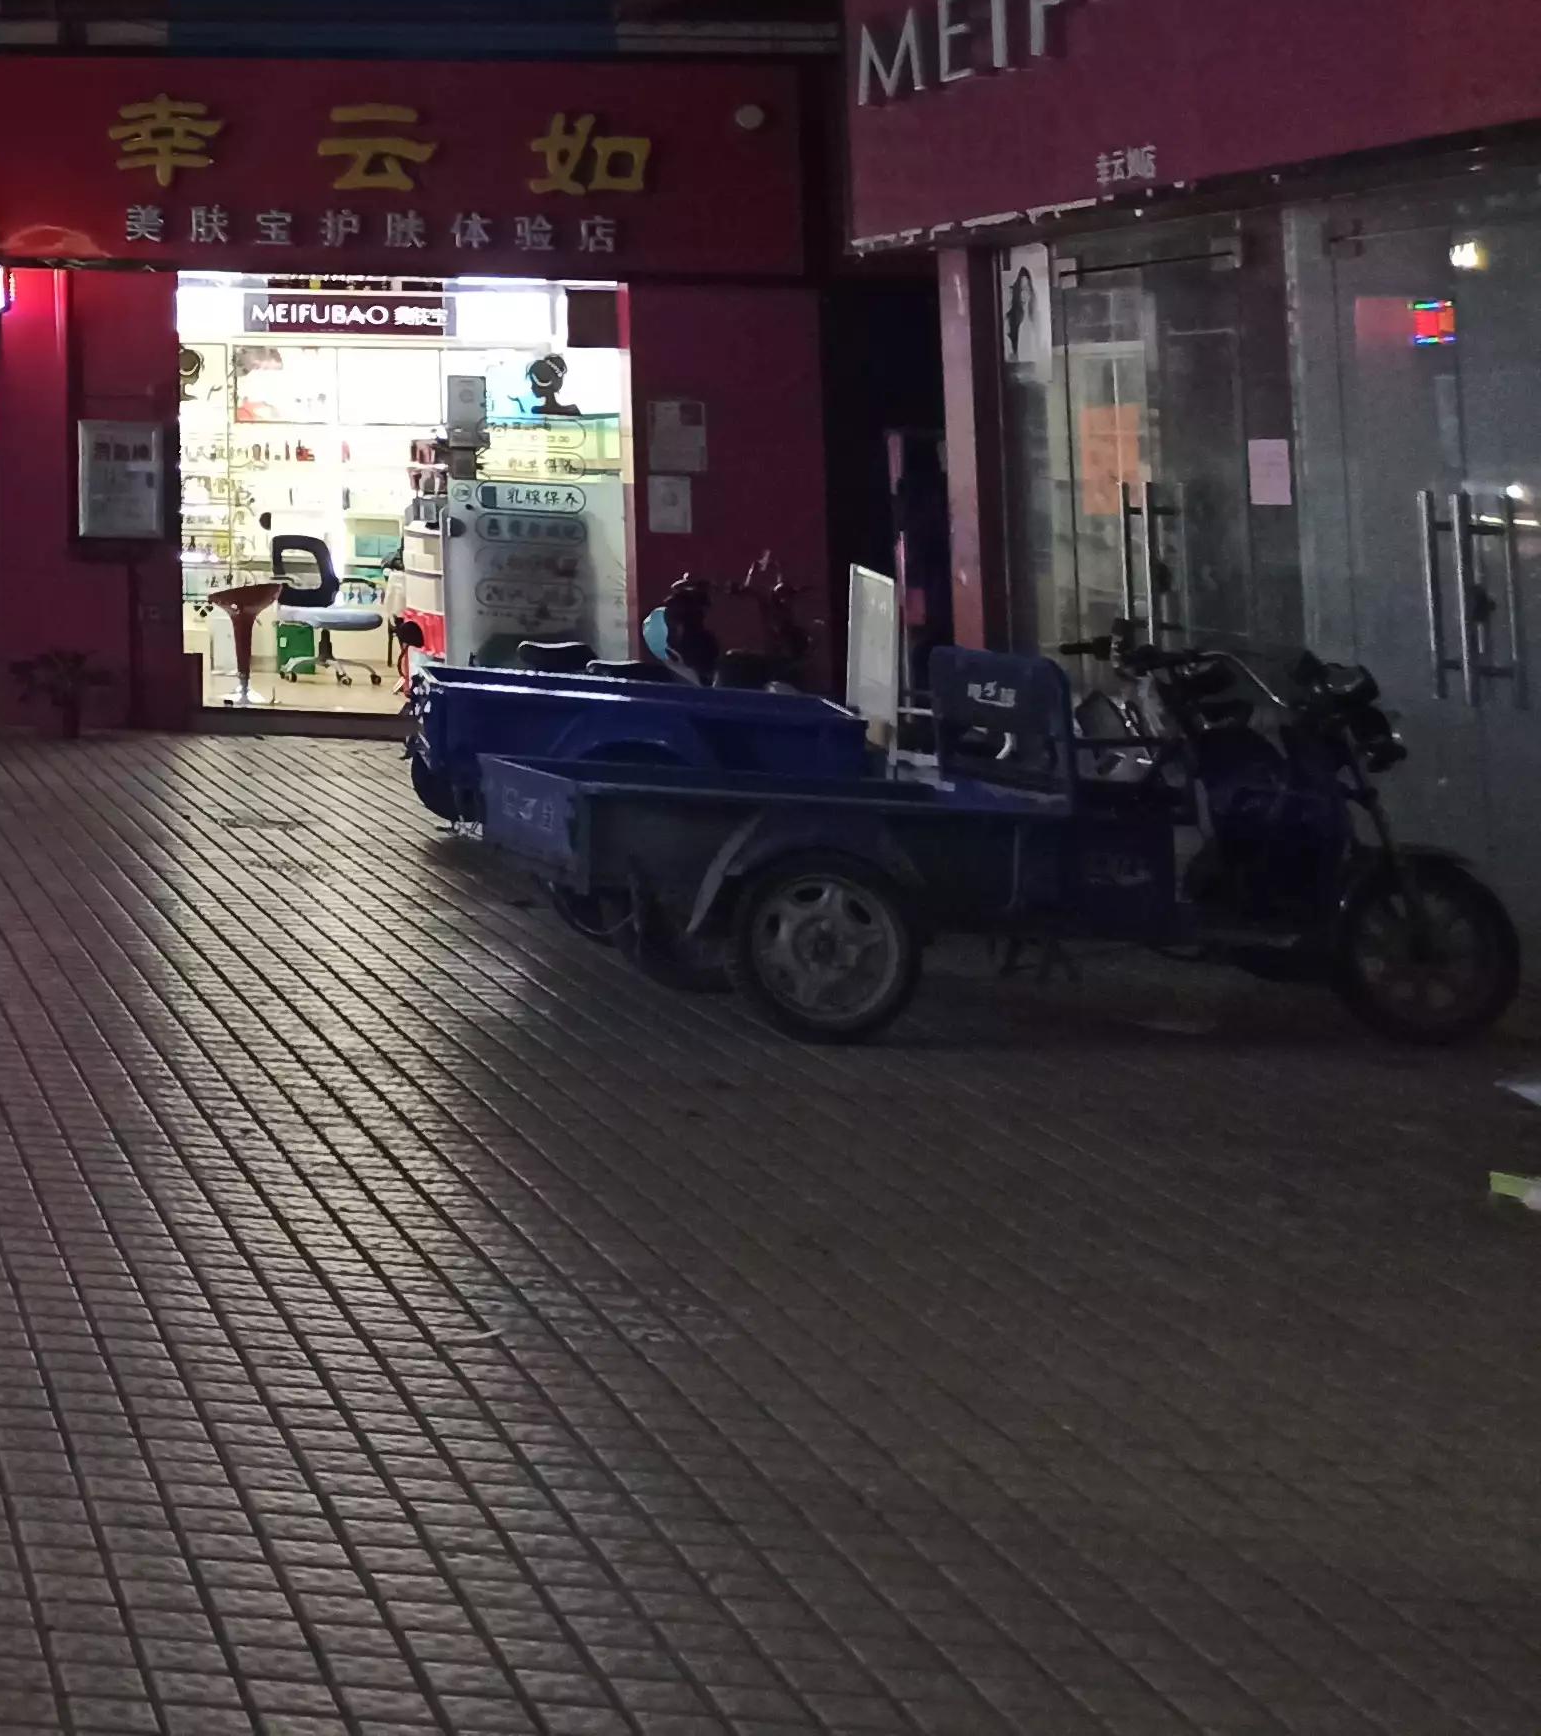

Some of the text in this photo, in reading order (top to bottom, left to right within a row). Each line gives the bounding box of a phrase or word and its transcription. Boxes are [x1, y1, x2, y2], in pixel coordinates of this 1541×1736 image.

[107, 93, 652, 196] 幸云如
[126, 204, 618, 253] 美肤宝护肤体验店
[251, 302, 389, 325] MEIFUBAO
